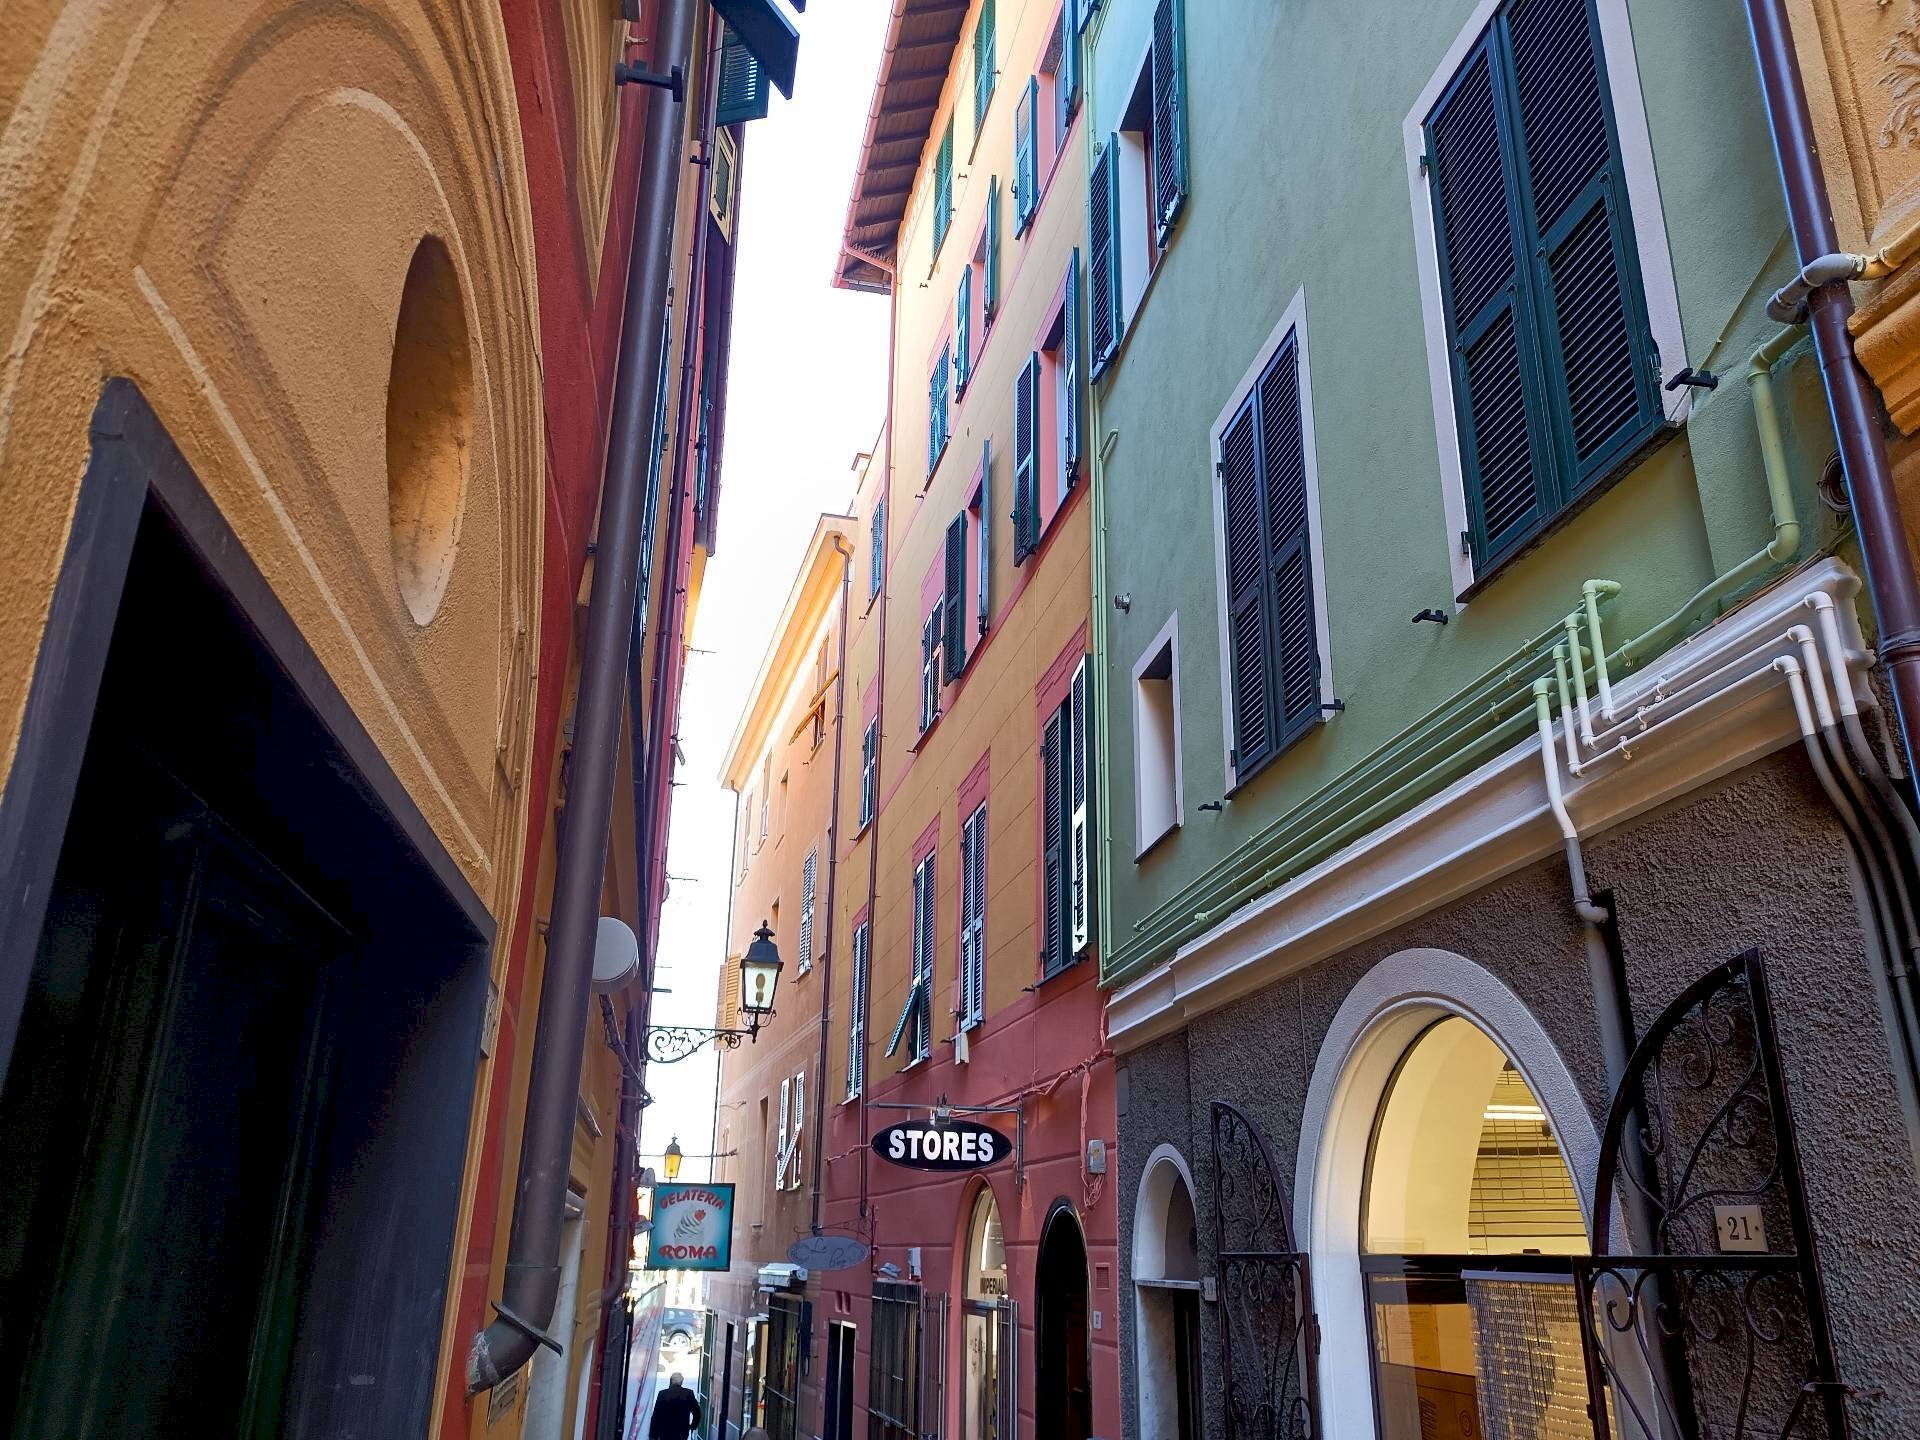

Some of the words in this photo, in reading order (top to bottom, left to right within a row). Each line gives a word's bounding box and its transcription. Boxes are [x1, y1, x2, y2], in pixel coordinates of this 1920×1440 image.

[888, 1129, 994, 1162] STORES
[659, 1188, 725, 1210] GELATERIA
[1727, 1216, 1752, 1240] 21
[658, 1244, 718, 1261] ROMA
